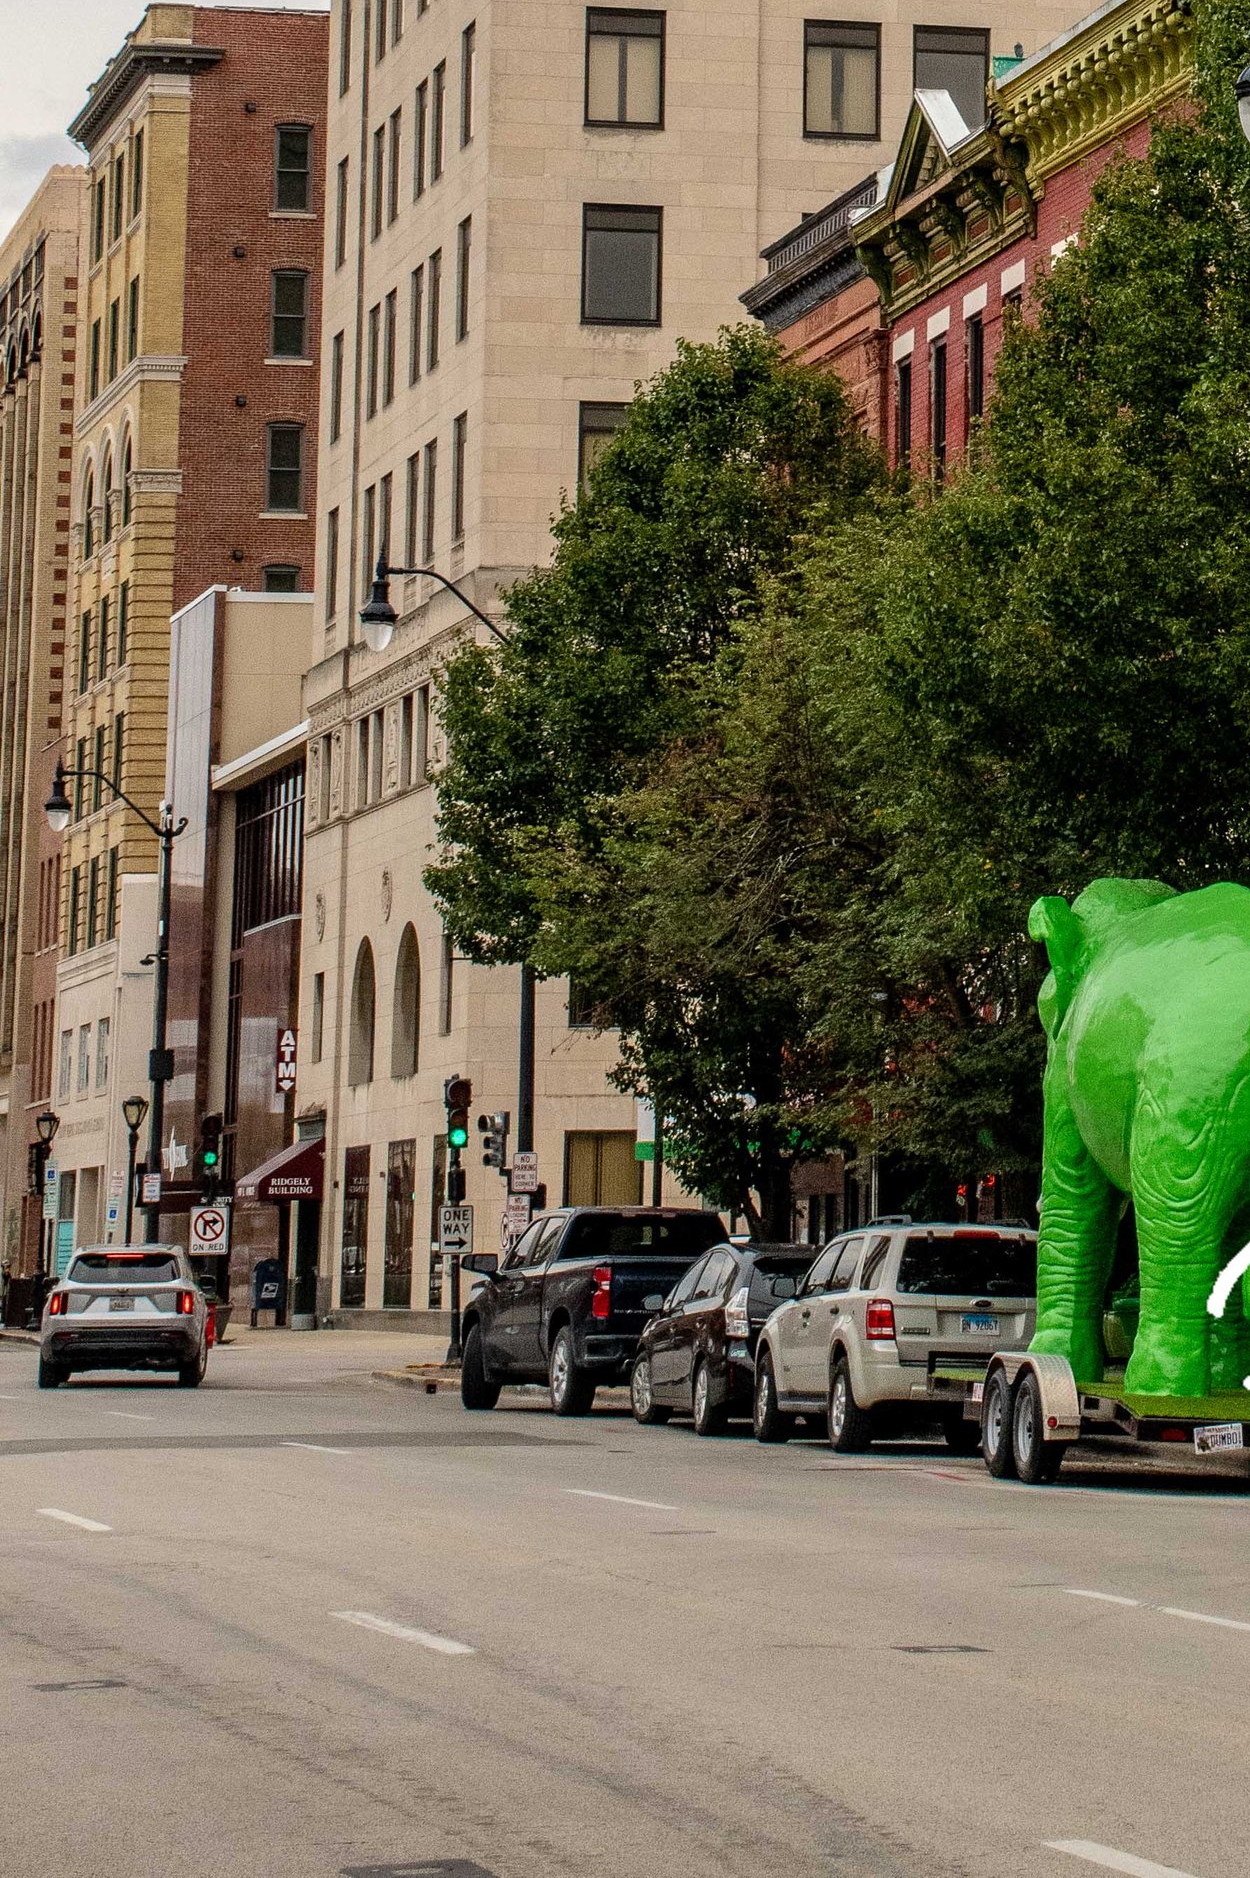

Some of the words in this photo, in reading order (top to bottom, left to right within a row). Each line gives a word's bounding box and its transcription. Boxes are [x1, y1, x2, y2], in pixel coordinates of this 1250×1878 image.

[278, 1030, 296, 1078] ATM
[514, 1163, 537, 1171] PARKING
[270, 1177, 311, 1186] RIDGELY
[268, 1186, 313, 1195] BUILDING
[443, 1209, 470, 1222] ONE
[442, 1223, 470, 1235] WAY
[193, 1243, 205, 1252] ON
[208, 1243, 224, 1251] RED
